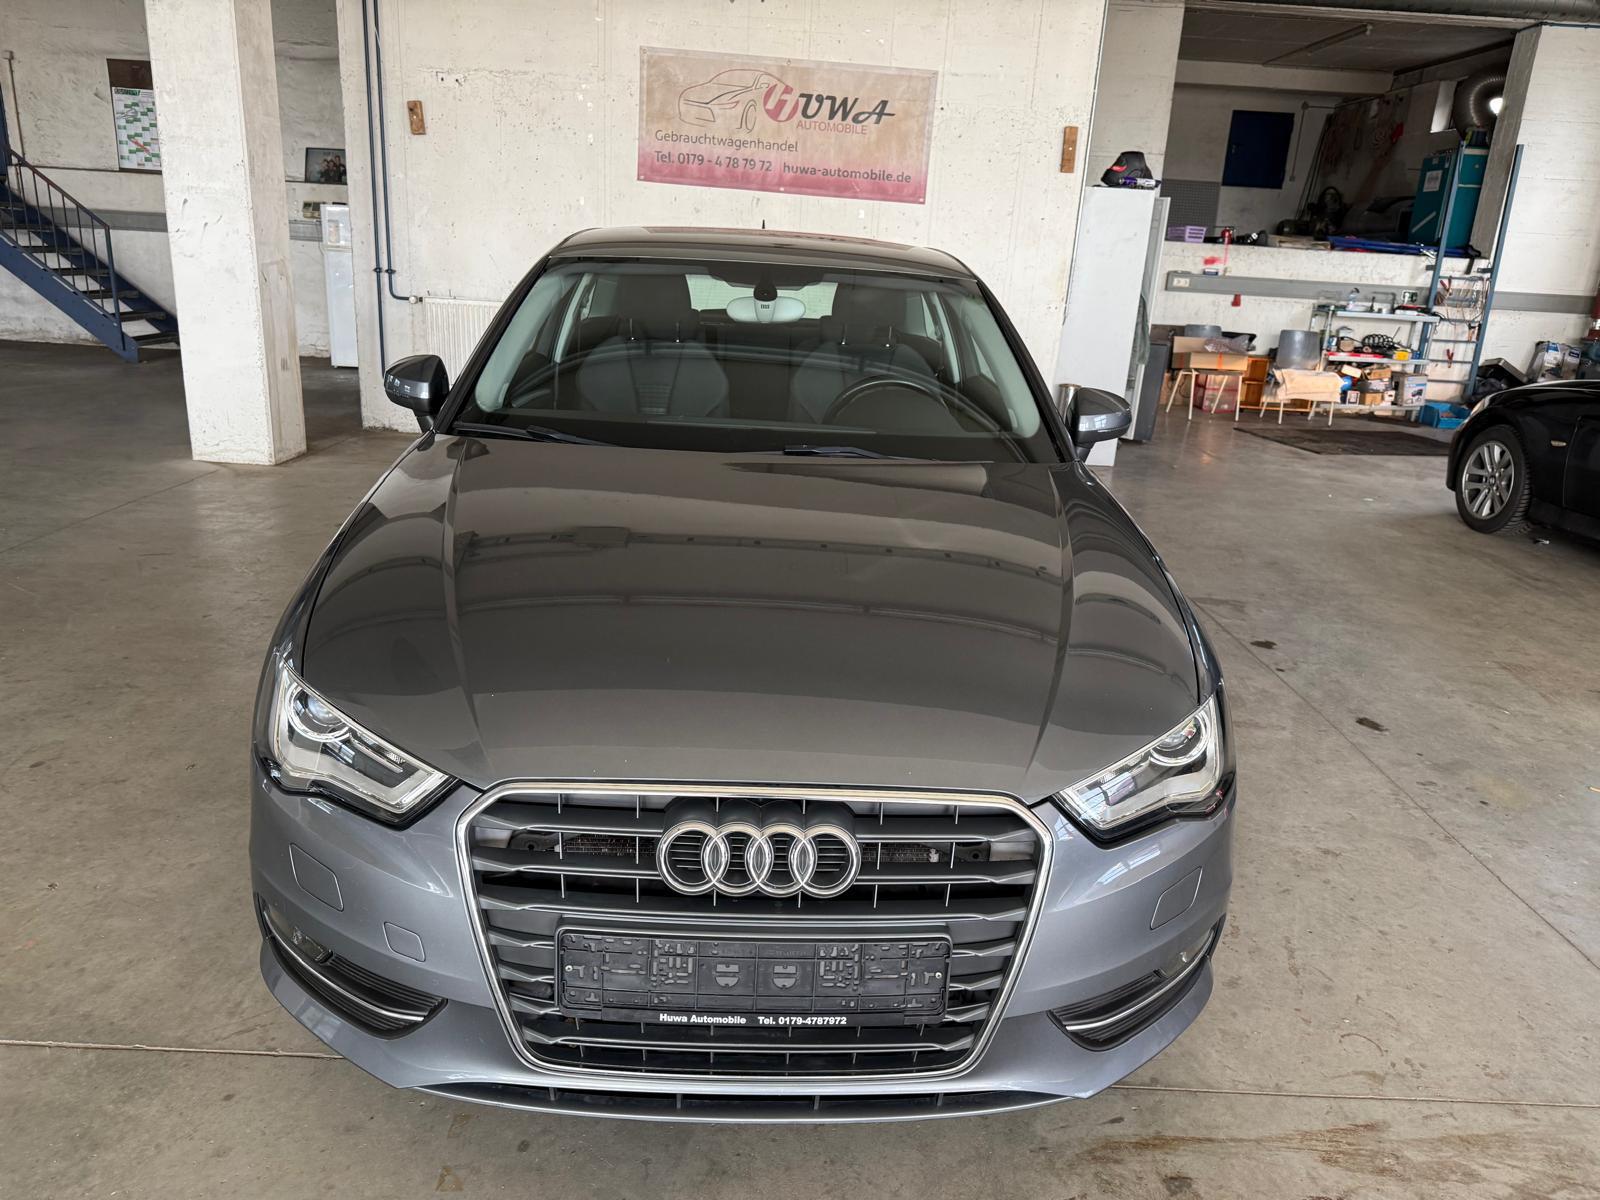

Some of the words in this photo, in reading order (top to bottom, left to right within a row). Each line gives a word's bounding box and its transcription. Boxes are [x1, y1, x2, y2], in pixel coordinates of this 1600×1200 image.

[796, 121, 868, 135] AUTOMOBILE
[655, 129, 799, 152] Gebrauchtwagenhandel
[654, 150, 675, 164] Tel.
[677, 152, 705, 166] 0179
[742, 158, 757, 170] 79
[760, 160, 773, 172] 72
[783, 162, 912, 183] huwa-automobile.de
[659, 1013, 688, 1023] Huwa
[690, 1014, 747, 1024] Automobile
[758, 1016, 776, 1025] Tel.
[778, 1016, 848, 1025] 0179-4787972
